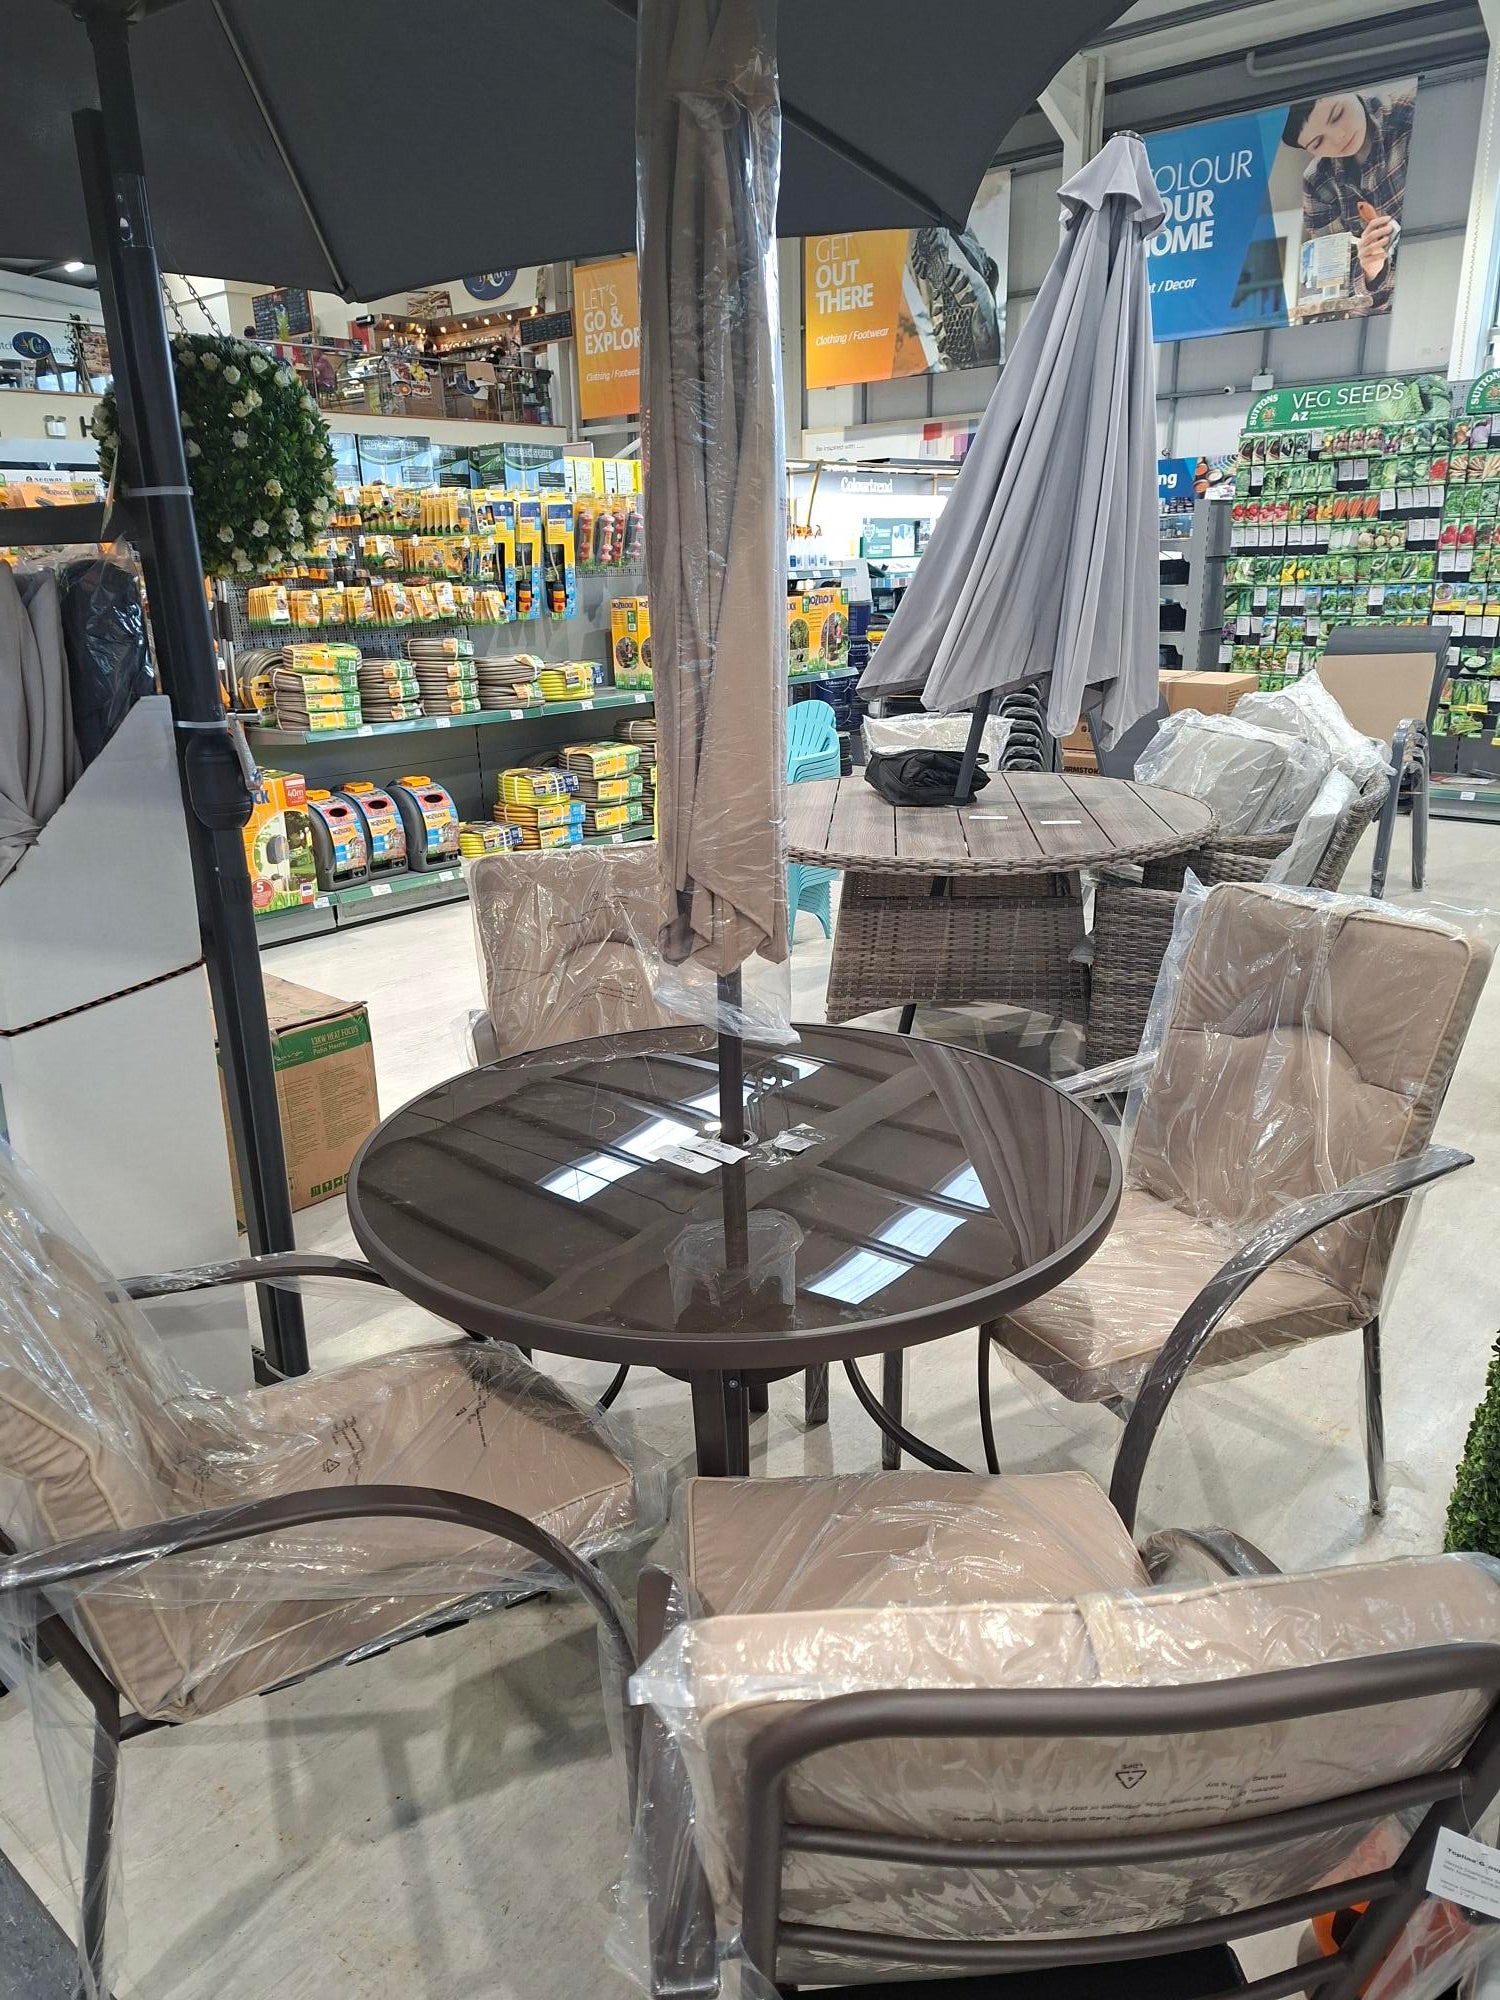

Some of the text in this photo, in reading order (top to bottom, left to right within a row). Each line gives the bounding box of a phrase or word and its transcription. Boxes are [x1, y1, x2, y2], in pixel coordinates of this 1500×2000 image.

[1160, 190, 1214, 224] OUR
[816, 234, 853, 263] GET
[815, 259, 860, 289] OUT
[1165, 278, 1197, 291] Decor
[582, 284, 618, 310] LET'S
[815, 283, 874, 315] THERE
[584, 310, 606, 333] GO
[610, 305, 624, 329] &
[584, 326, 640, 355] EXPLOR
[815, 331, 847, 346] Clothing
[853, 327, 890, 342] Footwear
[615, 367, 640, 378] Footwea
[1293, 382, 1405, 409] VEG SEEDS
[1470, 371, 1500, 405] SUTTON
[1250, 393, 1279, 426] SUTTONS
[1158, 473, 1178, 488] ng
[808, 594, 834, 606] OZELOK
[1063, 766, 1101, 775] ARMSTOK
[253, 790, 270, 804] CK
[288, 788, 304, 799] 40m
[256, 881, 264, 893] 5
[327, 1030, 341, 1042] HEAT
[341, 1025, 359, 1037] FOCUS
